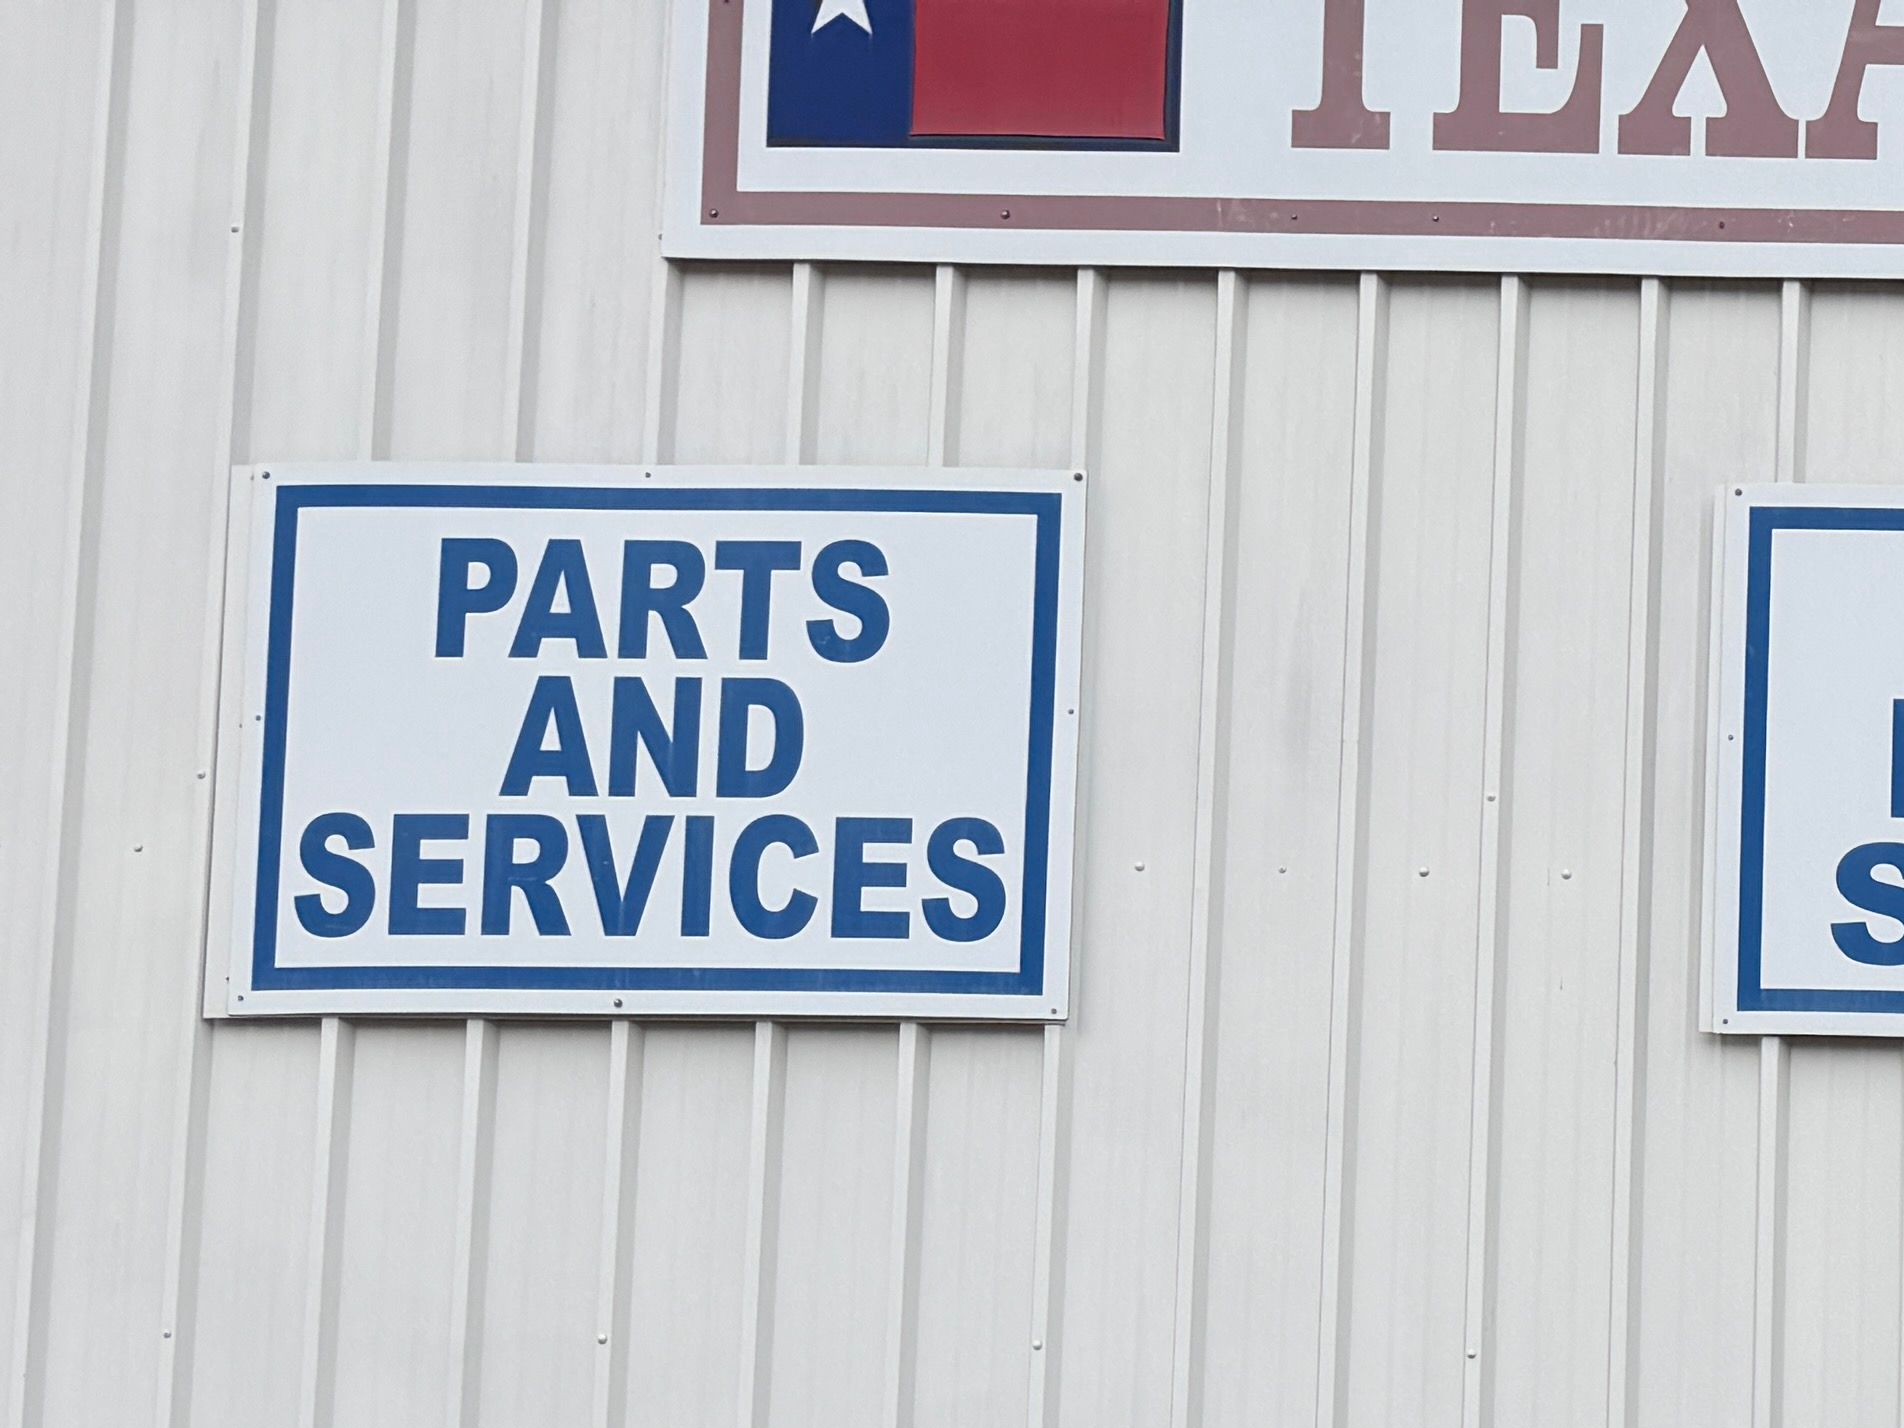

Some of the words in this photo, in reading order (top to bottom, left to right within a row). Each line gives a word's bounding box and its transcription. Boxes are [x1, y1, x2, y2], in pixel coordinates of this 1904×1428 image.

[435, 538, 890, 663] PARTS
[500, 676, 803, 798] AND
[294, 812, 1007, 942] SERVICES
